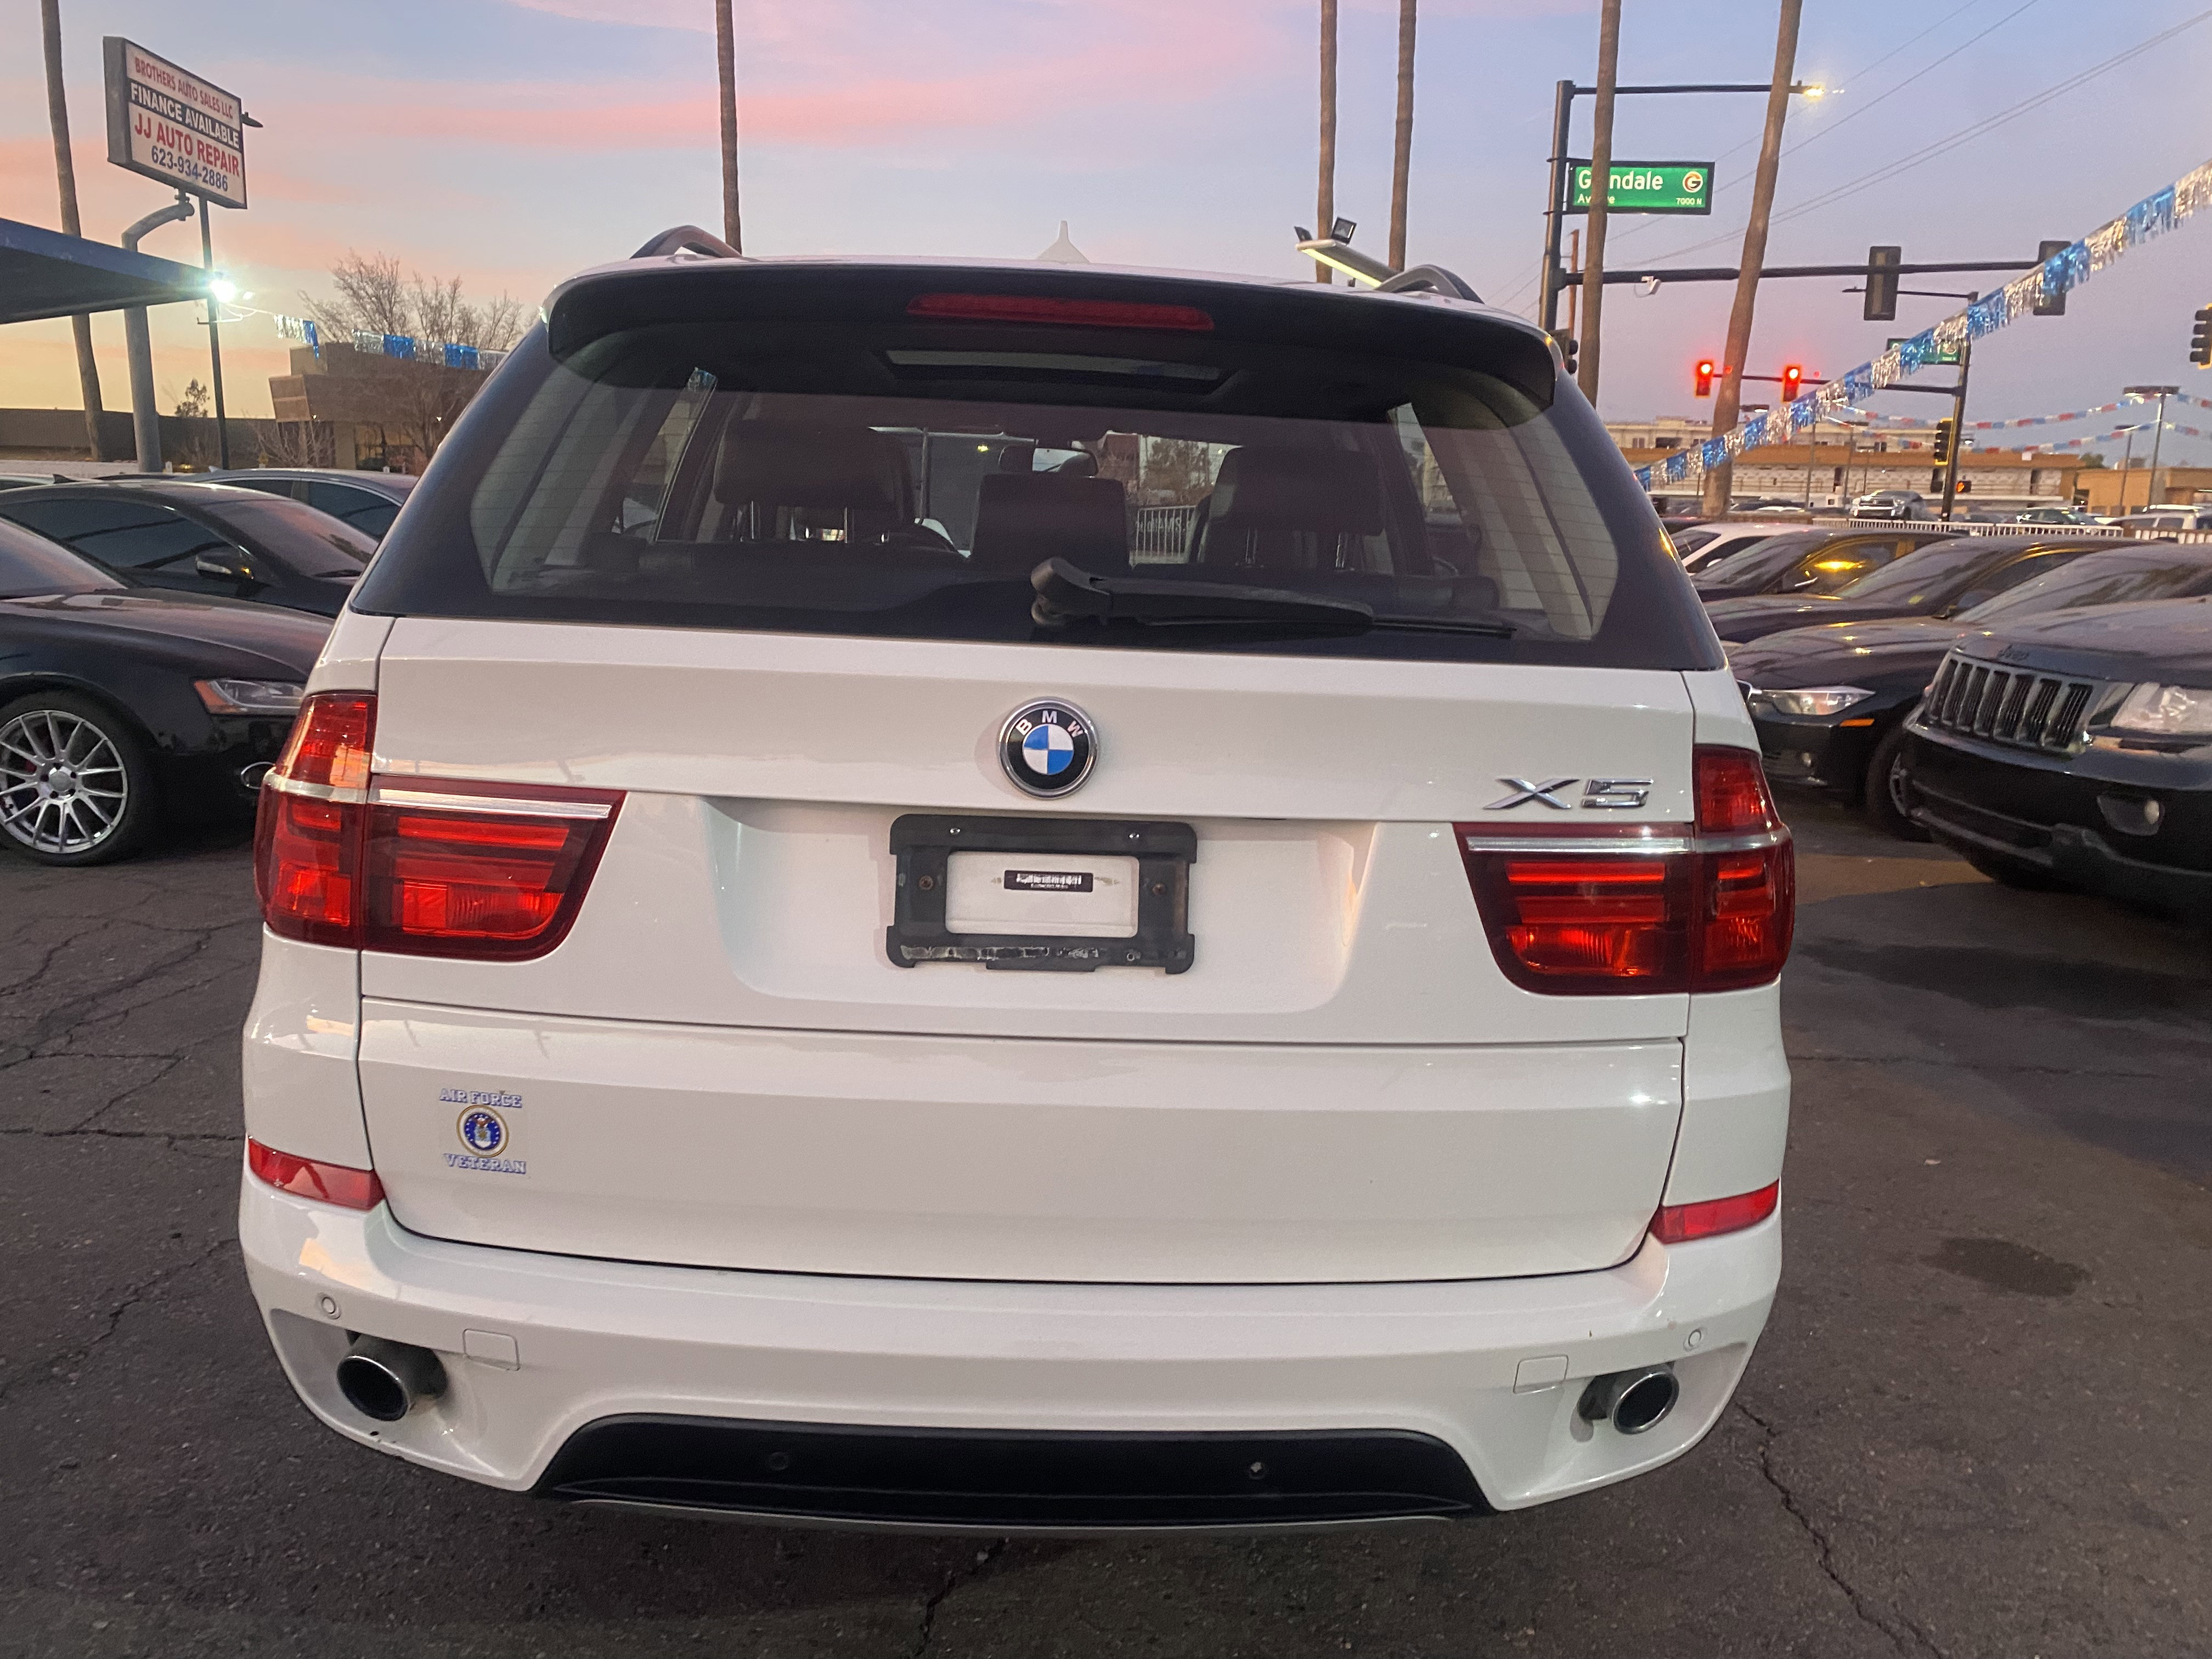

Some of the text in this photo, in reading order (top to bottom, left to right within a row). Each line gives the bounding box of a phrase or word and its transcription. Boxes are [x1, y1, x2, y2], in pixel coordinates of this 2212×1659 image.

[135, 57, 234, 120] BROTHERS AUTO SALES LLC
[131, 82, 240, 149] FINANCE AVAILABLE
[134, 112, 240, 177] JJ AUTO REPAIR
[151, 145, 228, 192] 623-934-2886
[1578, 170, 1664, 190] Gndale
[1577, 193, 1616, 204] Ave
[1676, 198, 1702, 206] 7000 N
[1015, 710, 1084, 738] BMW
[1482, 777, 1655, 810] X5
[439, 1088, 522, 1109] AIR FORCE
[442, 1153, 527, 1175] VETERAN
